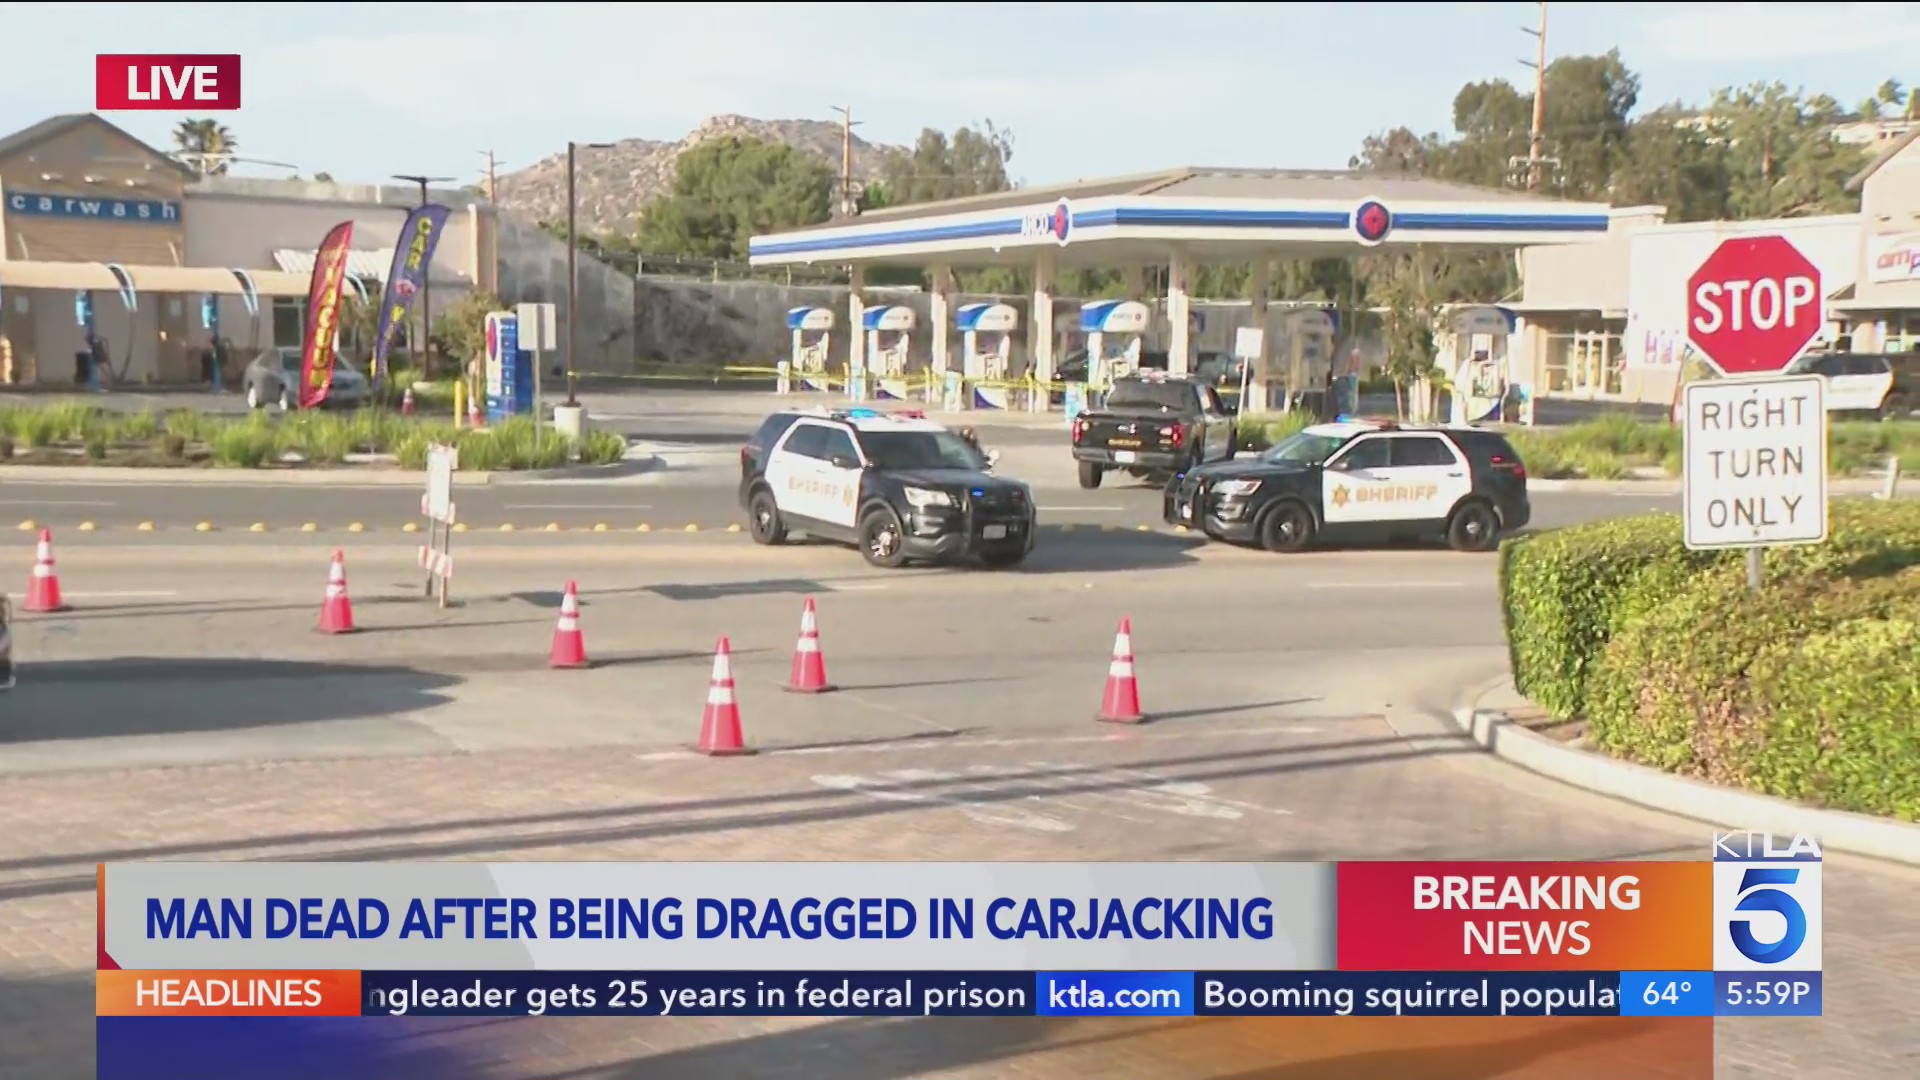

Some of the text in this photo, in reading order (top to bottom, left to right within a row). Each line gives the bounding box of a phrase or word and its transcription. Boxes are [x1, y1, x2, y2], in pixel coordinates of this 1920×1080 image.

[1693, 276, 1815, 334] STOP
[1702, 396, 1808, 430] RIGHT
[1708, 446, 1803, 480] TURN
[1355, 485, 1438, 503] SHERIFF
[1708, 496, 1803, 528] ONLY
